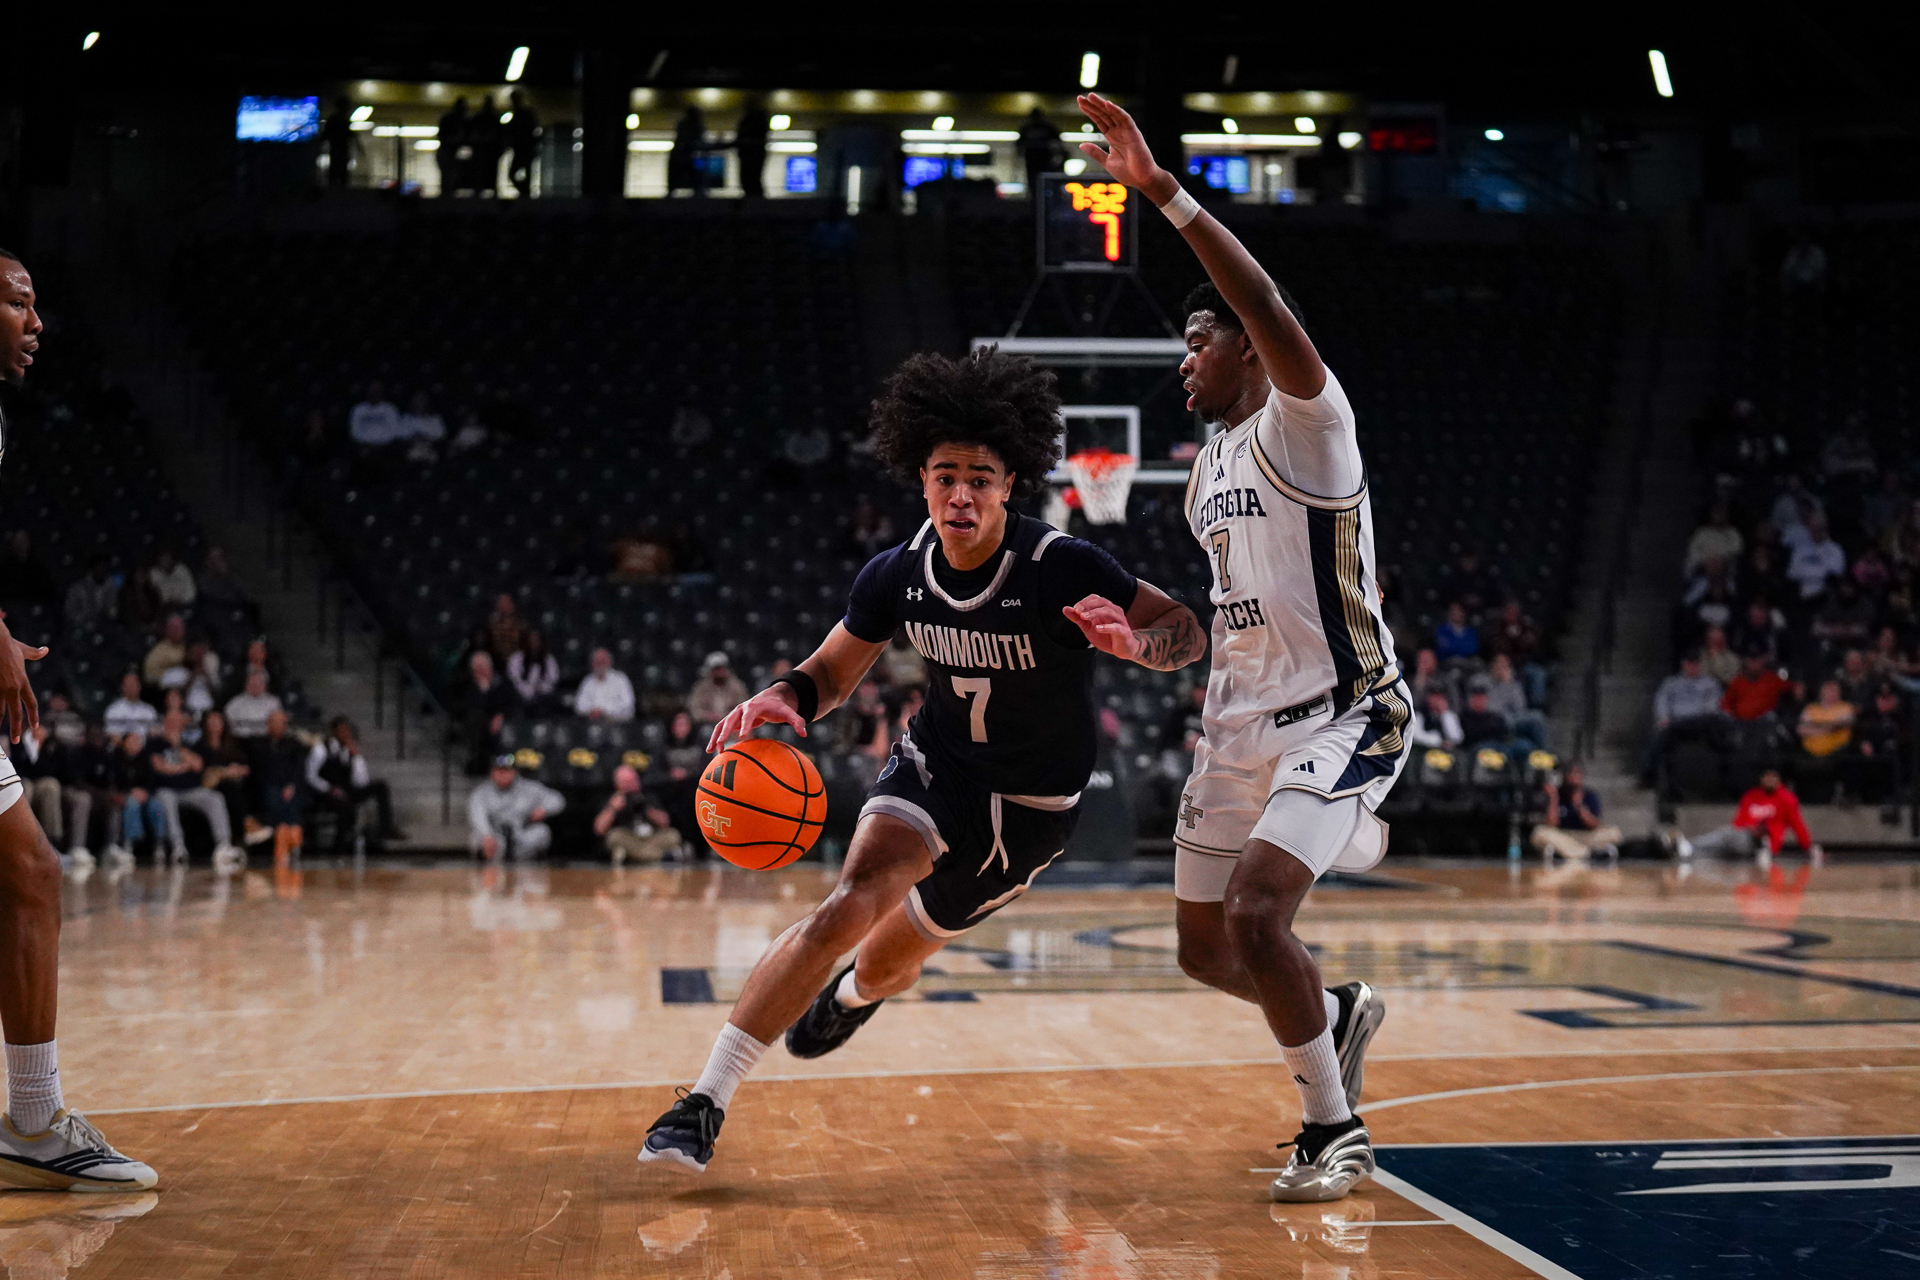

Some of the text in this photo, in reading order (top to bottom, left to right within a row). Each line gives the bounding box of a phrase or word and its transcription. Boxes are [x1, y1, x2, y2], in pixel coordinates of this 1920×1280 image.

[1089, 212, 1120, 261] 7
[1200, 488, 1267, 535] EORGIA
[1209, 528, 1231, 593] 7
[1001, 599, 1022, 607] CAA
[1218, 598, 1266, 630] ECH
[905, 621, 1036, 671] MONMOUTH
[951, 676, 992, 743] 7
[699, 800, 731, 837] GT
